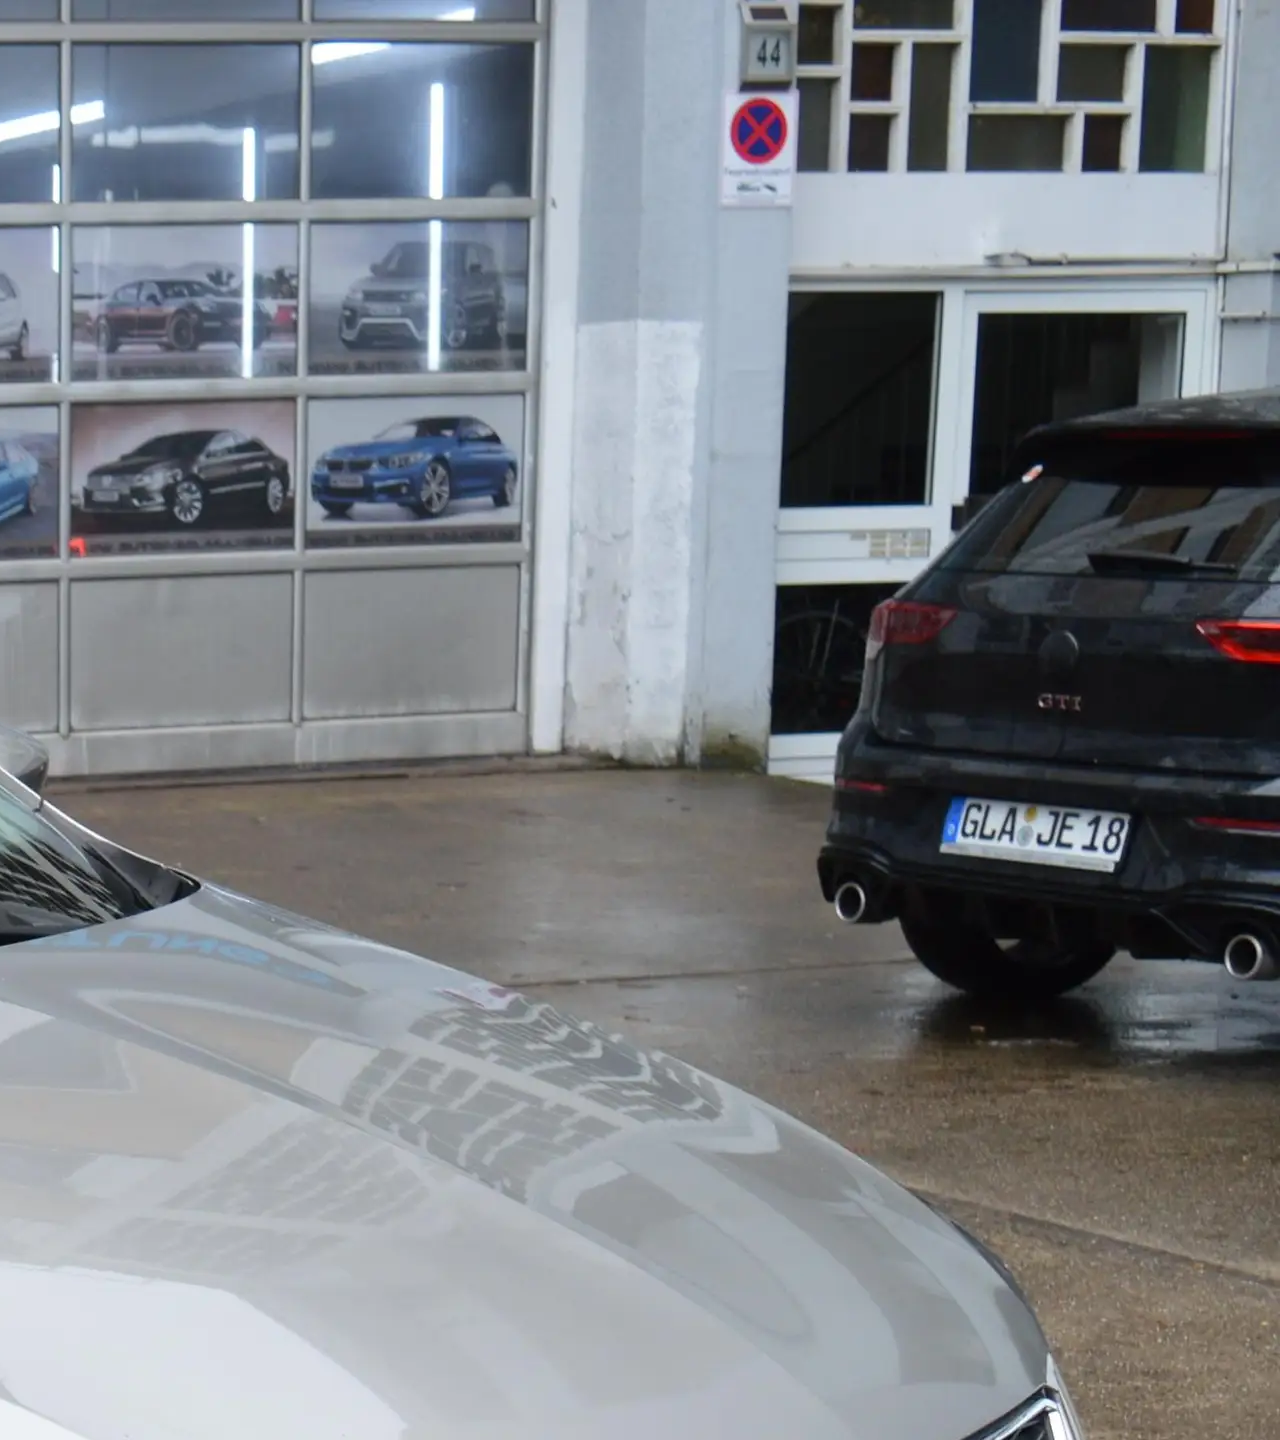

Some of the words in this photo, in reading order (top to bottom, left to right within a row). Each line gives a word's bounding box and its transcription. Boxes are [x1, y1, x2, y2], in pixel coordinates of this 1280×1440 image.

[757, 38, 780, 68] 44
[1038, 692, 1082, 711] GTI
[961, 803, 1019, 843] GLA
[1036, 811, 1081, 849] JE
[1081, 814, 1126, 854] 18
